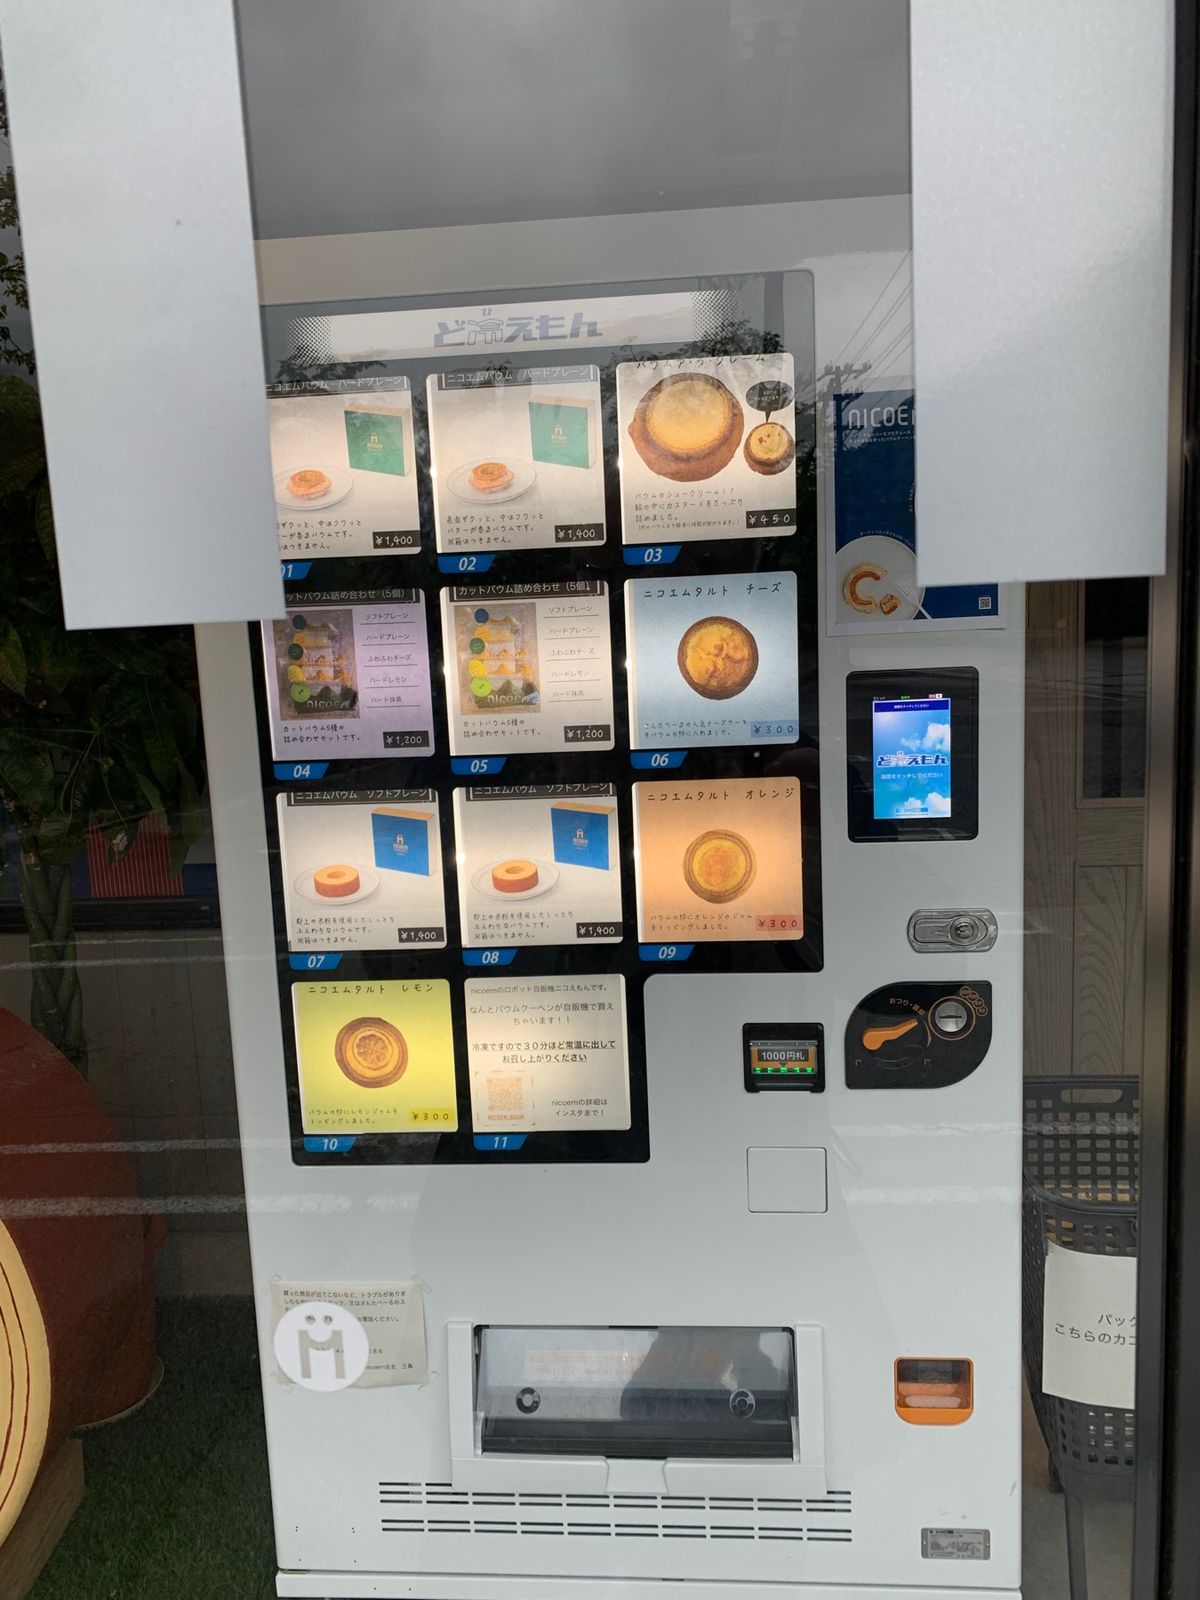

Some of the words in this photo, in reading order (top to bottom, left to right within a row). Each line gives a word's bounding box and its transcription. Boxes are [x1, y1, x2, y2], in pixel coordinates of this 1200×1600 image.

[434, 312, 603, 347] ど冷えもん
[375, 535, 413, 547] ¥1,400
[557, 529, 596, 541] ¥1,400
[644, 548, 662, 562] 03
[459, 557, 477, 571] 02
[644, 585, 728, 598] ニコエムタルト
[746, 582, 782, 595] チーズ
[567, 730, 604, 741] ¥1,200
[753, 725, 794, 735] ¥300
[385, 736, 423, 746] ¥1,200
[651, 753, 669, 766] 06
[293, 765, 311, 778] 04
[471, 760, 488, 773] 05
[647, 791, 729, 801] ニコエムタルト
[746, 787, 795, 800] オレンジ
[758, 919, 798, 928] ¥300
[401, 931, 436, 941] ¥1,400
[579, 926, 615, 936] ¥1,400
[482, 951, 499, 964] 08
[658, 946, 676, 959] 09
[308, 956, 325, 968] 07
[308, 985, 385, 995] ニコエムタルト
[402, 983, 433, 992] レモン
[470, 1002, 614, 1014] なんとバウムクーヘンが自販機で買え
[502, 1053, 587, 1063] お召し上がりください
[761, 1051, 805, 1061] 1000円札
[412, 1111, 449, 1121] ¥300
[322, 1139, 338, 1150] 10
[493, 1137, 508, 1149] 11
